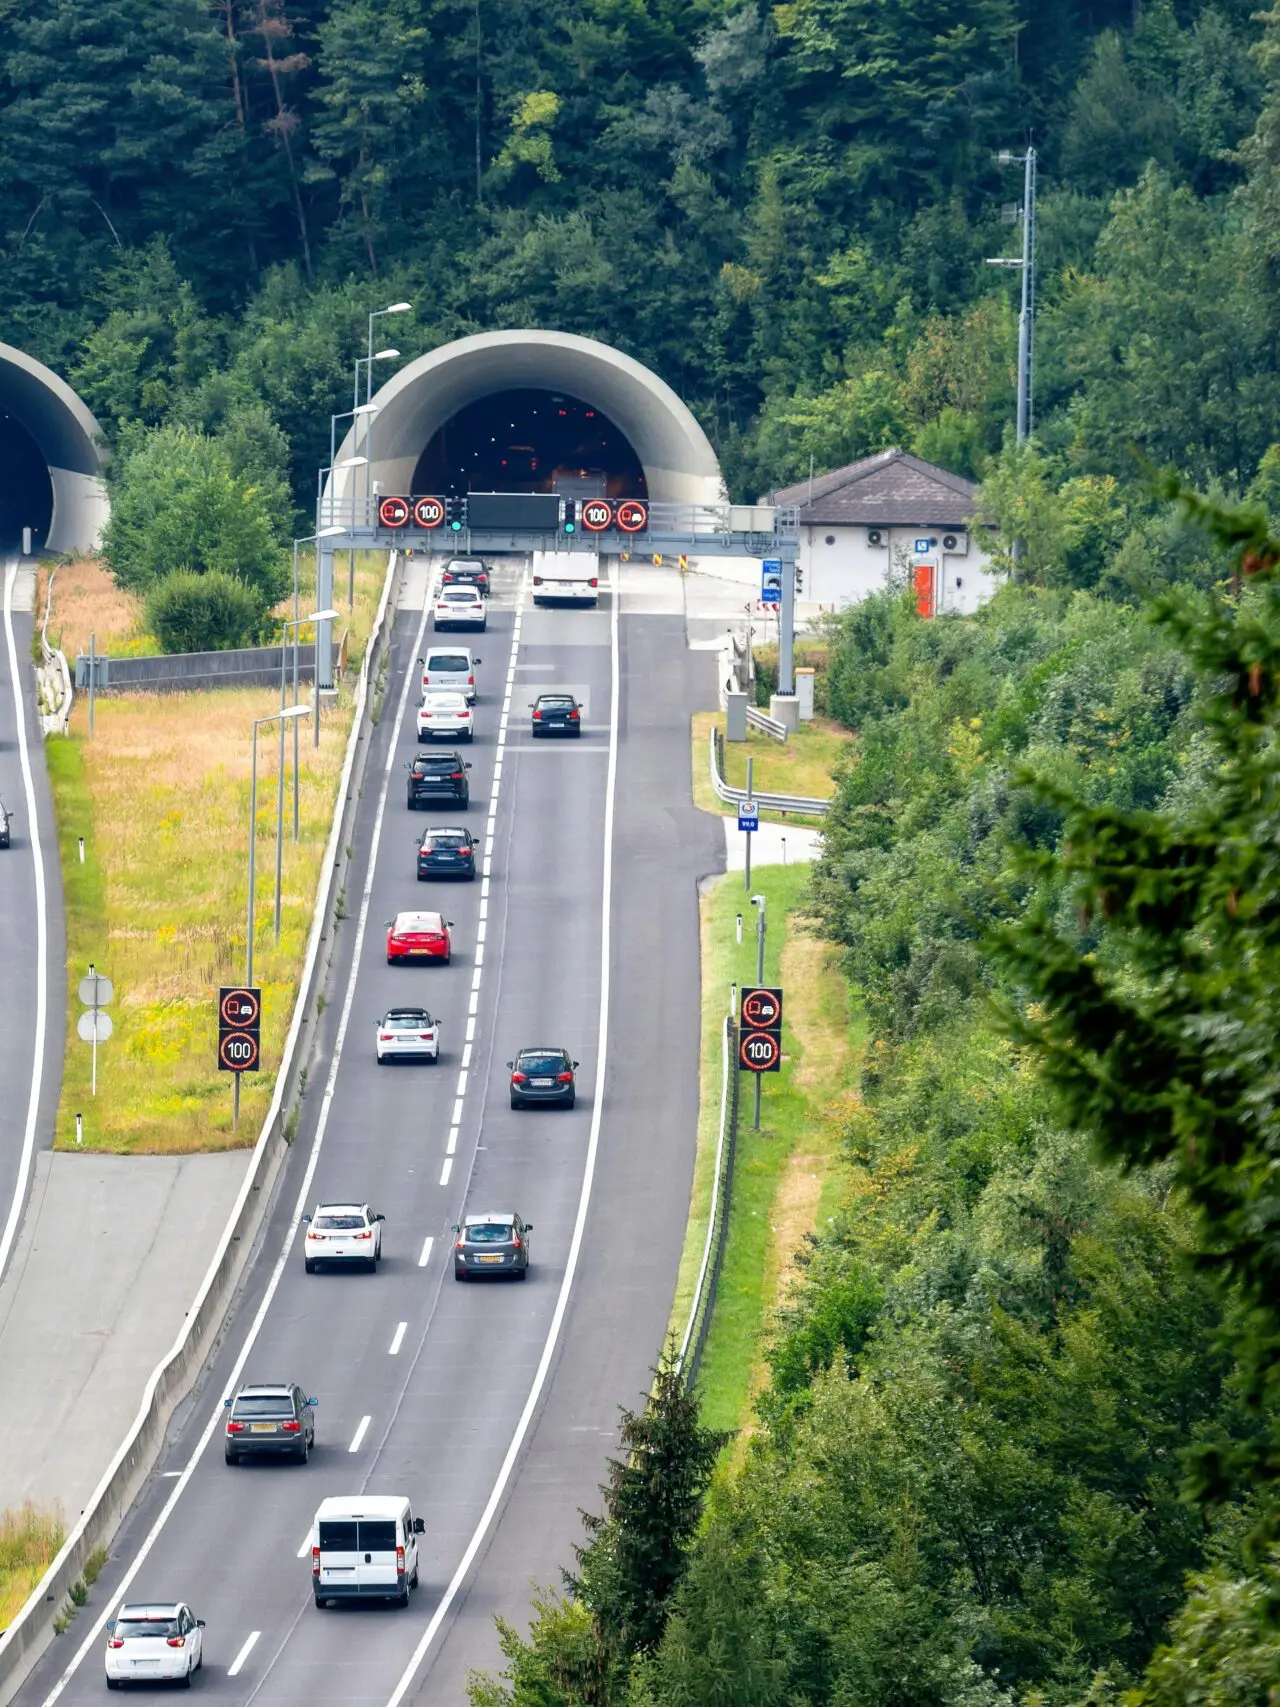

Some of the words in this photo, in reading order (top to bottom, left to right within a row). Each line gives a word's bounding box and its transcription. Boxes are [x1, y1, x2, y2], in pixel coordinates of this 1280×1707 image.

[420, 505, 439, 519] 100
[588, 508, 607, 522] 100
[228, 1042, 251, 1059] 100
[748, 1042, 772, 1059] 100
